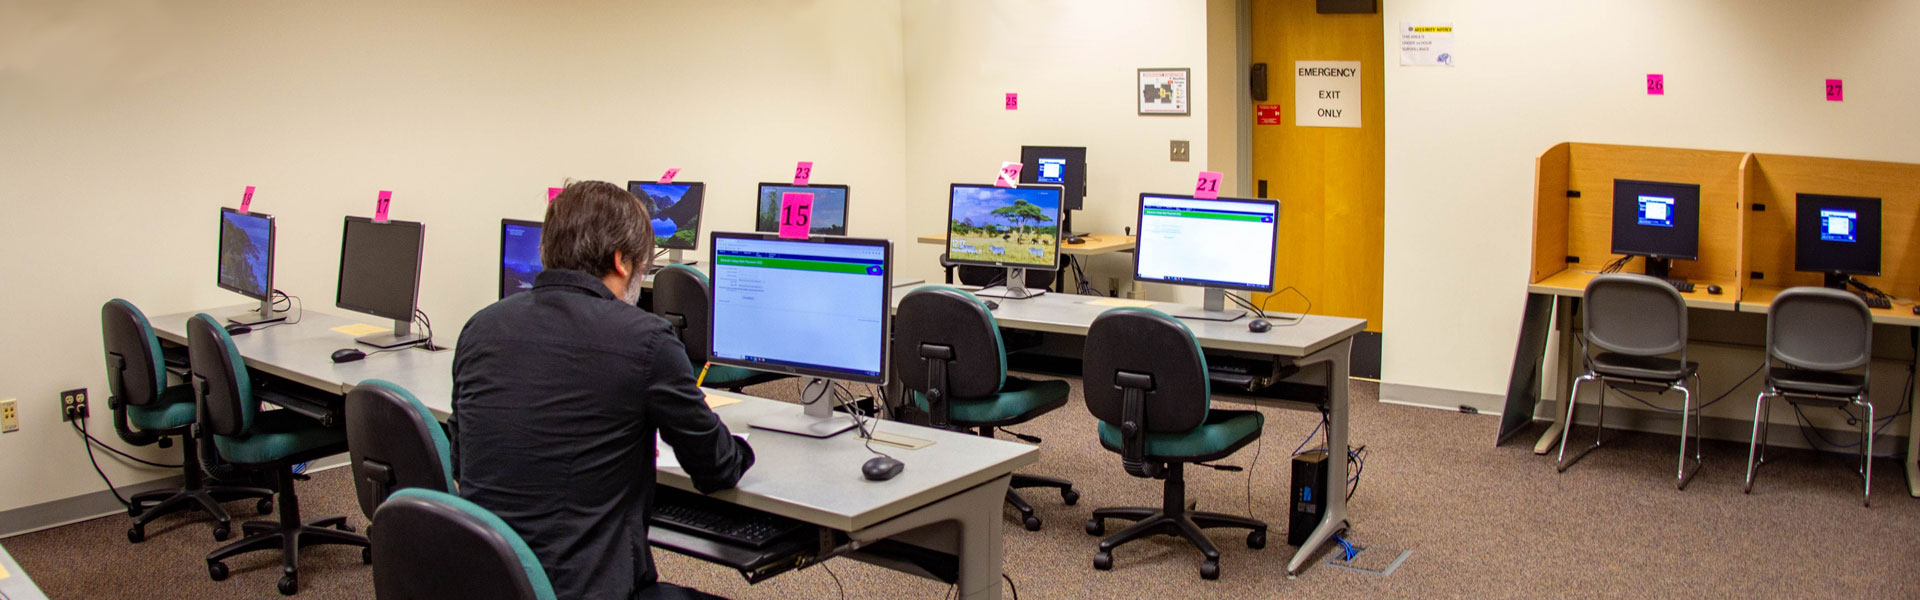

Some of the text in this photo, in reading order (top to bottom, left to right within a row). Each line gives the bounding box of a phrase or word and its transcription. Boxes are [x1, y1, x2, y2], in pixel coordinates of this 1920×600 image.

[1298, 67, 1356, 77] EMERGENCY
[1647, 79, 1664, 90] 26
[1318, 90, 1341, 99] EXIT
[1826, 84, 1842, 97] 27
[1005, 96, 1017, 106] 25
[1317, 108, 1342, 118] ONLY
[661, 170, 677, 179] 24
[794, 167, 810, 179] 23
[1196, 177, 1218, 192] 21
[241, 192, 253, 206] 18
[377, 198, 390, 214] 17
[782, 204, 809, 227] 15
